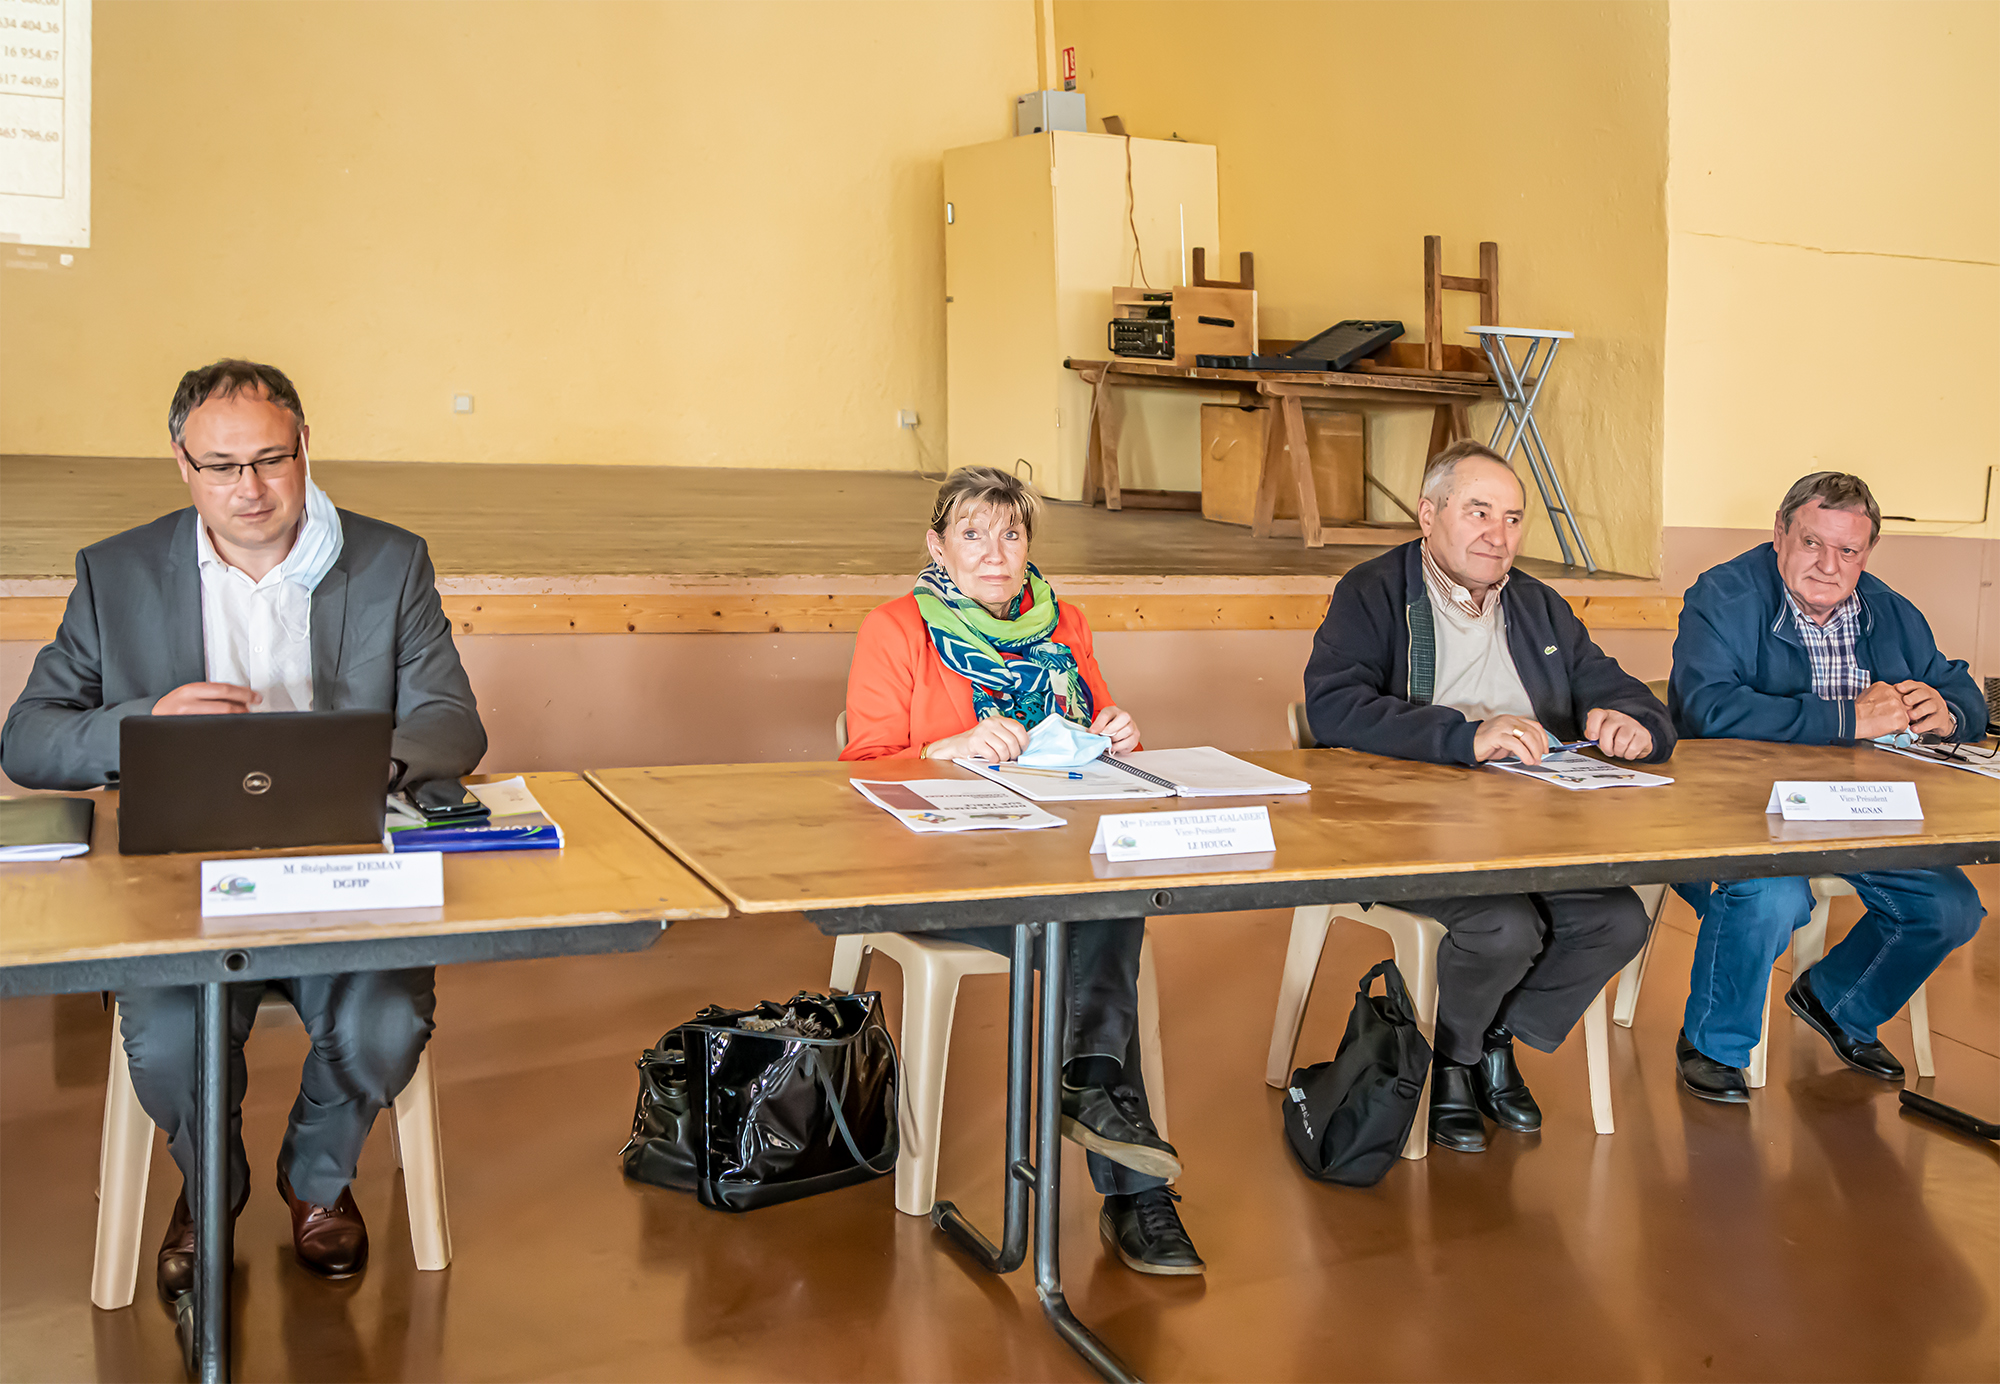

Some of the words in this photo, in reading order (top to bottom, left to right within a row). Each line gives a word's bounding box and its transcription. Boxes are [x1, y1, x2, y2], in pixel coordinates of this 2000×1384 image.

[4, 45, 17, 57] 16
[1857, 785, 1894, 793] DUCLAVE
[1850, 806, 1883, 814] MAGNAN
[1187, 841, 1199, 850] LE
[1201, 839, 1233, 849] HOUGA
[301, 862, 354, 875] Stéphane
[357, 860, 403, 871] DEMAY
[332, 878, 370, 889] DGFIP
